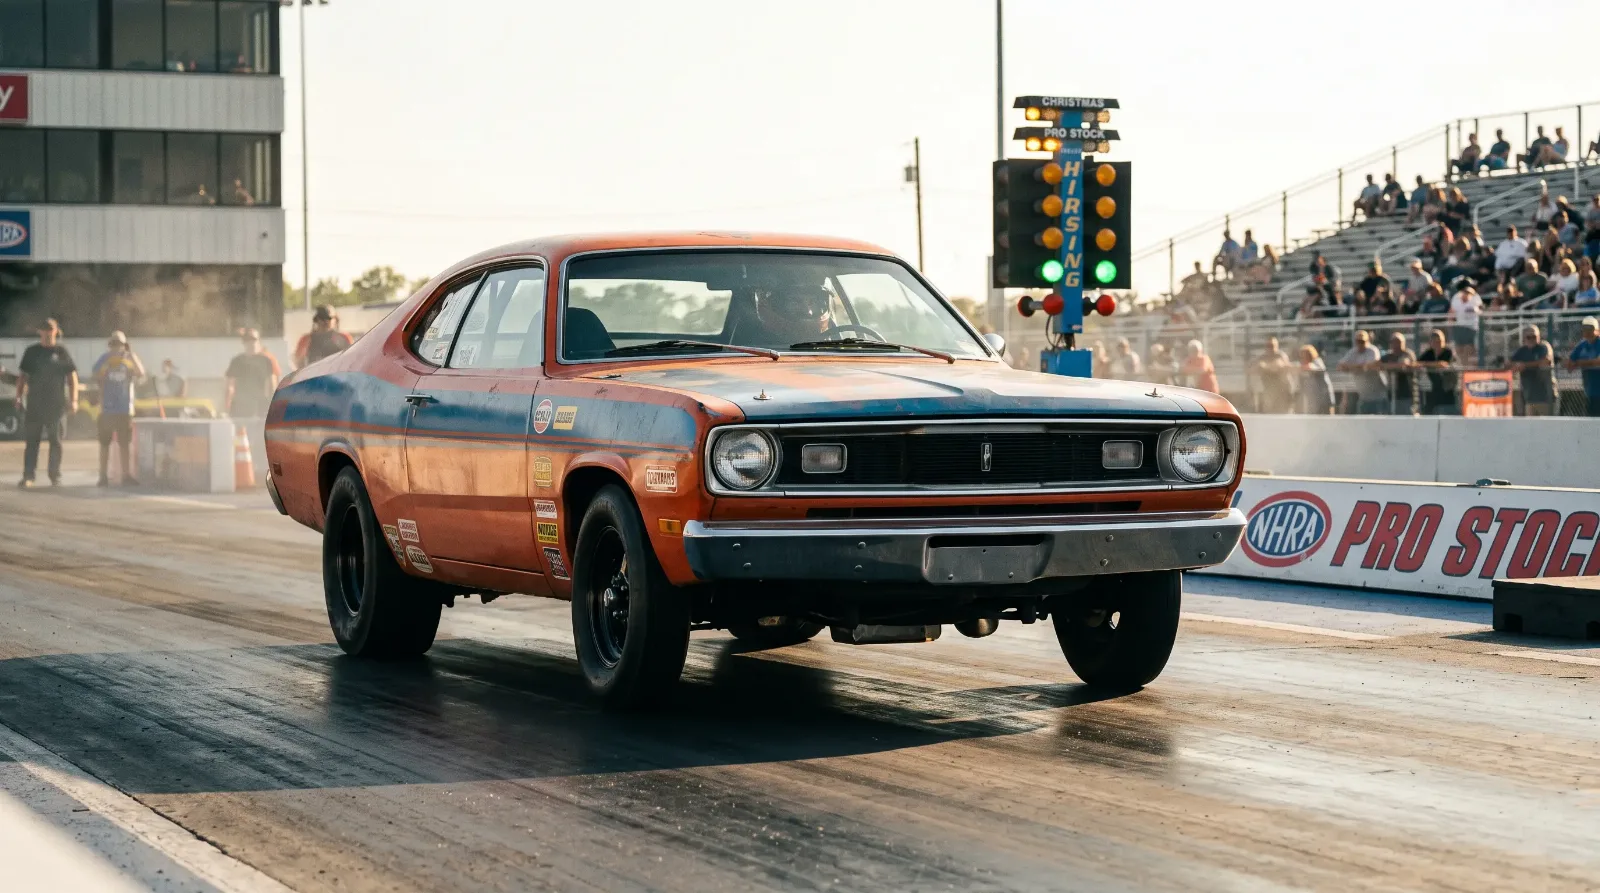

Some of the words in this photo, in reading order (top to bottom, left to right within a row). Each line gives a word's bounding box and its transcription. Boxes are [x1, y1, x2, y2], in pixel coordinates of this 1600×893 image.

[1042, 96, 1105, 108] CHRISTMAS
[1044, 127, 1067, 138] PRO
[1070, 128, 1106, 139] STOCK
[1063, 160, 1082, 288] HIRSING
[1250, 504, 1318, 553] NHRA
[1330, 500, 1444, 573] PRO
[1441, 505, 1600, 579] STOC
